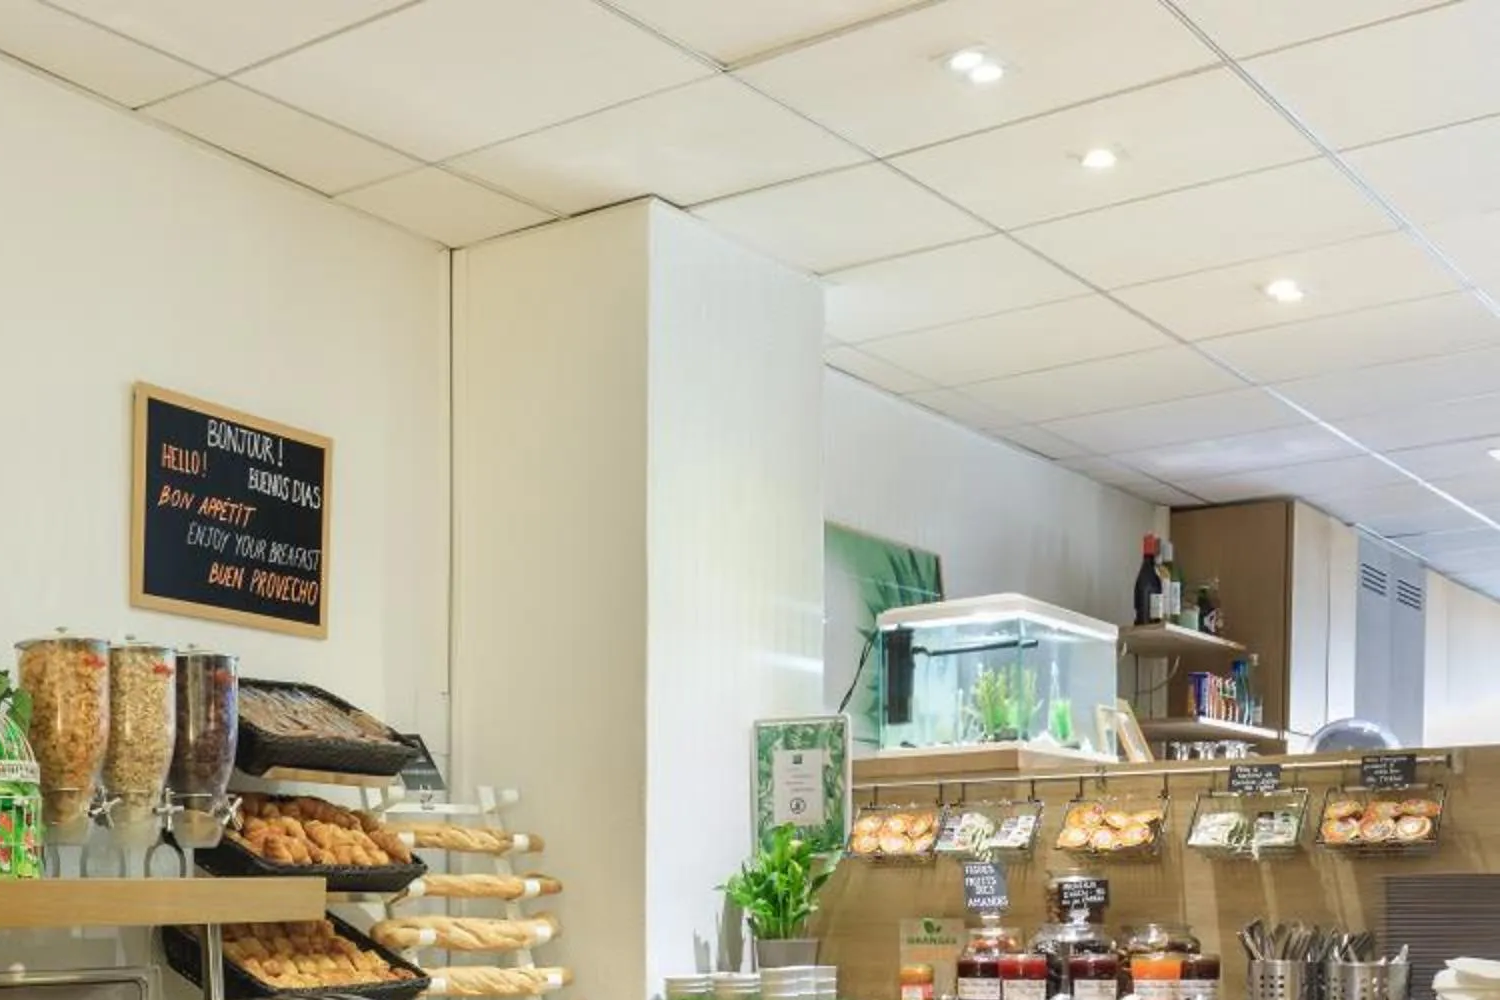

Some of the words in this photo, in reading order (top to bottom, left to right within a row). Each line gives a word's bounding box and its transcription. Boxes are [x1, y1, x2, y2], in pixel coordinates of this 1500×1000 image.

[207, 419, 275, 465] BONJOUR
[158, 484, 194, 510] BON
[248, 467, 289, 501] BUENOS
[291, 479, 320, 509] DIAS
[187, 521, 230, 552] ENJOY
[235, 531, 267, 563] YOUR
[209, 562, 243, 590] BUEN
[250, 570, 318, 606] PROVECHO
